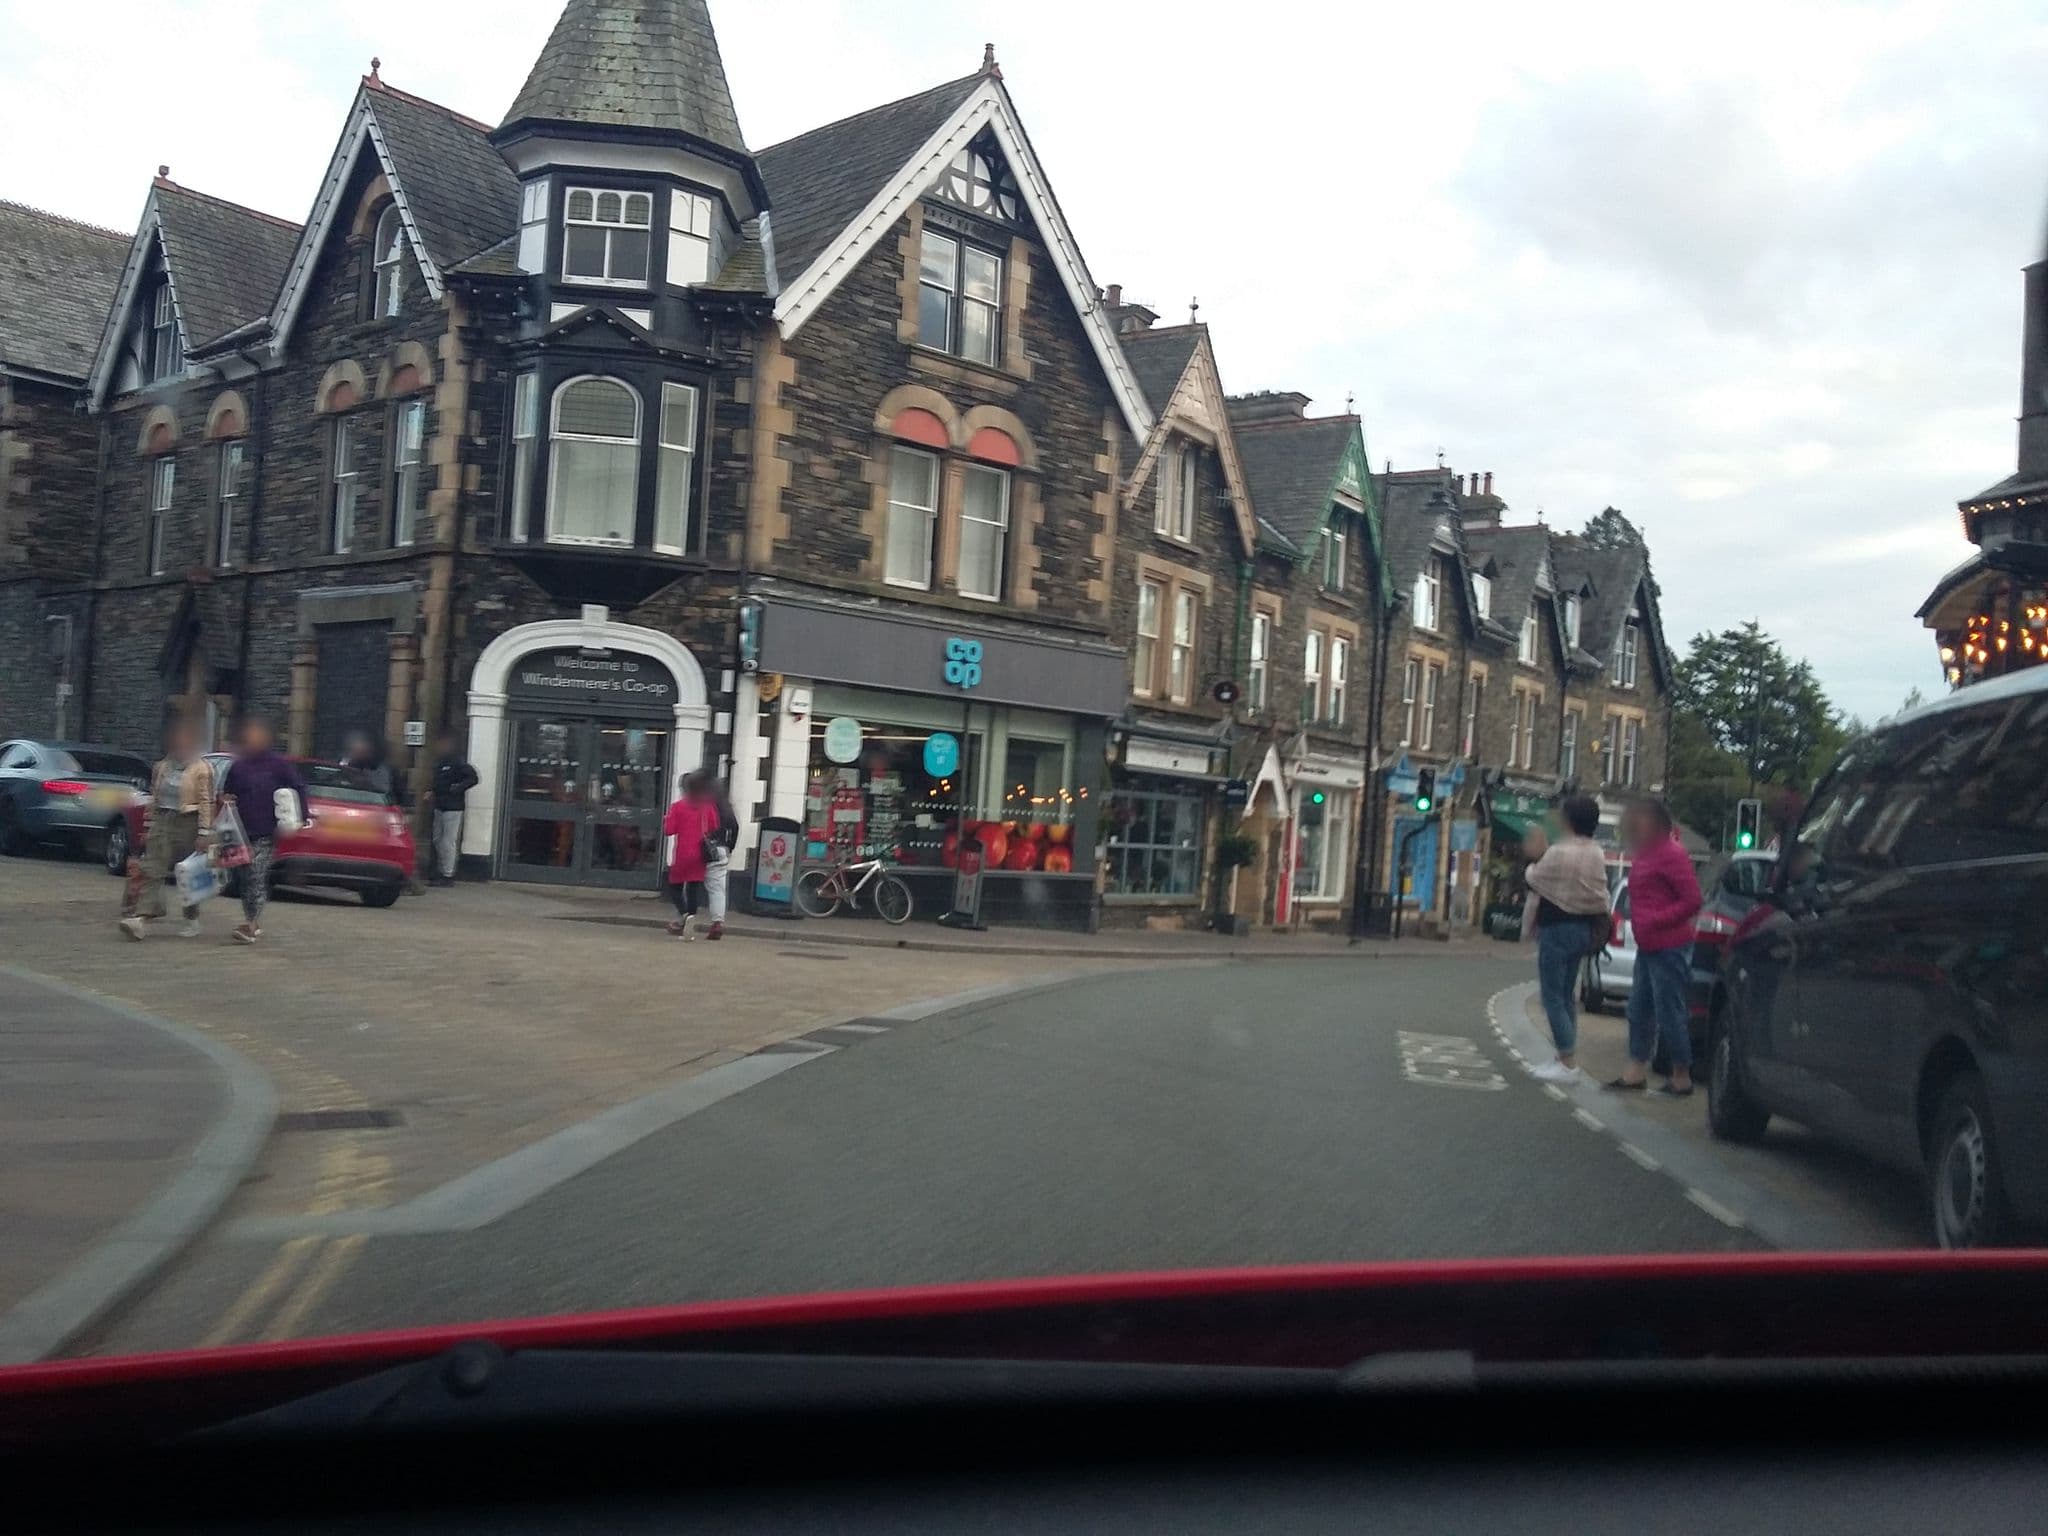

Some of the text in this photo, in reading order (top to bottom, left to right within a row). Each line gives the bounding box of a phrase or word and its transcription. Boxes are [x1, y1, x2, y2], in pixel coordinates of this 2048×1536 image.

[554, 655, 640, 672] Welcome to
[522, 672, 669, 697] Windermere's Co-op
